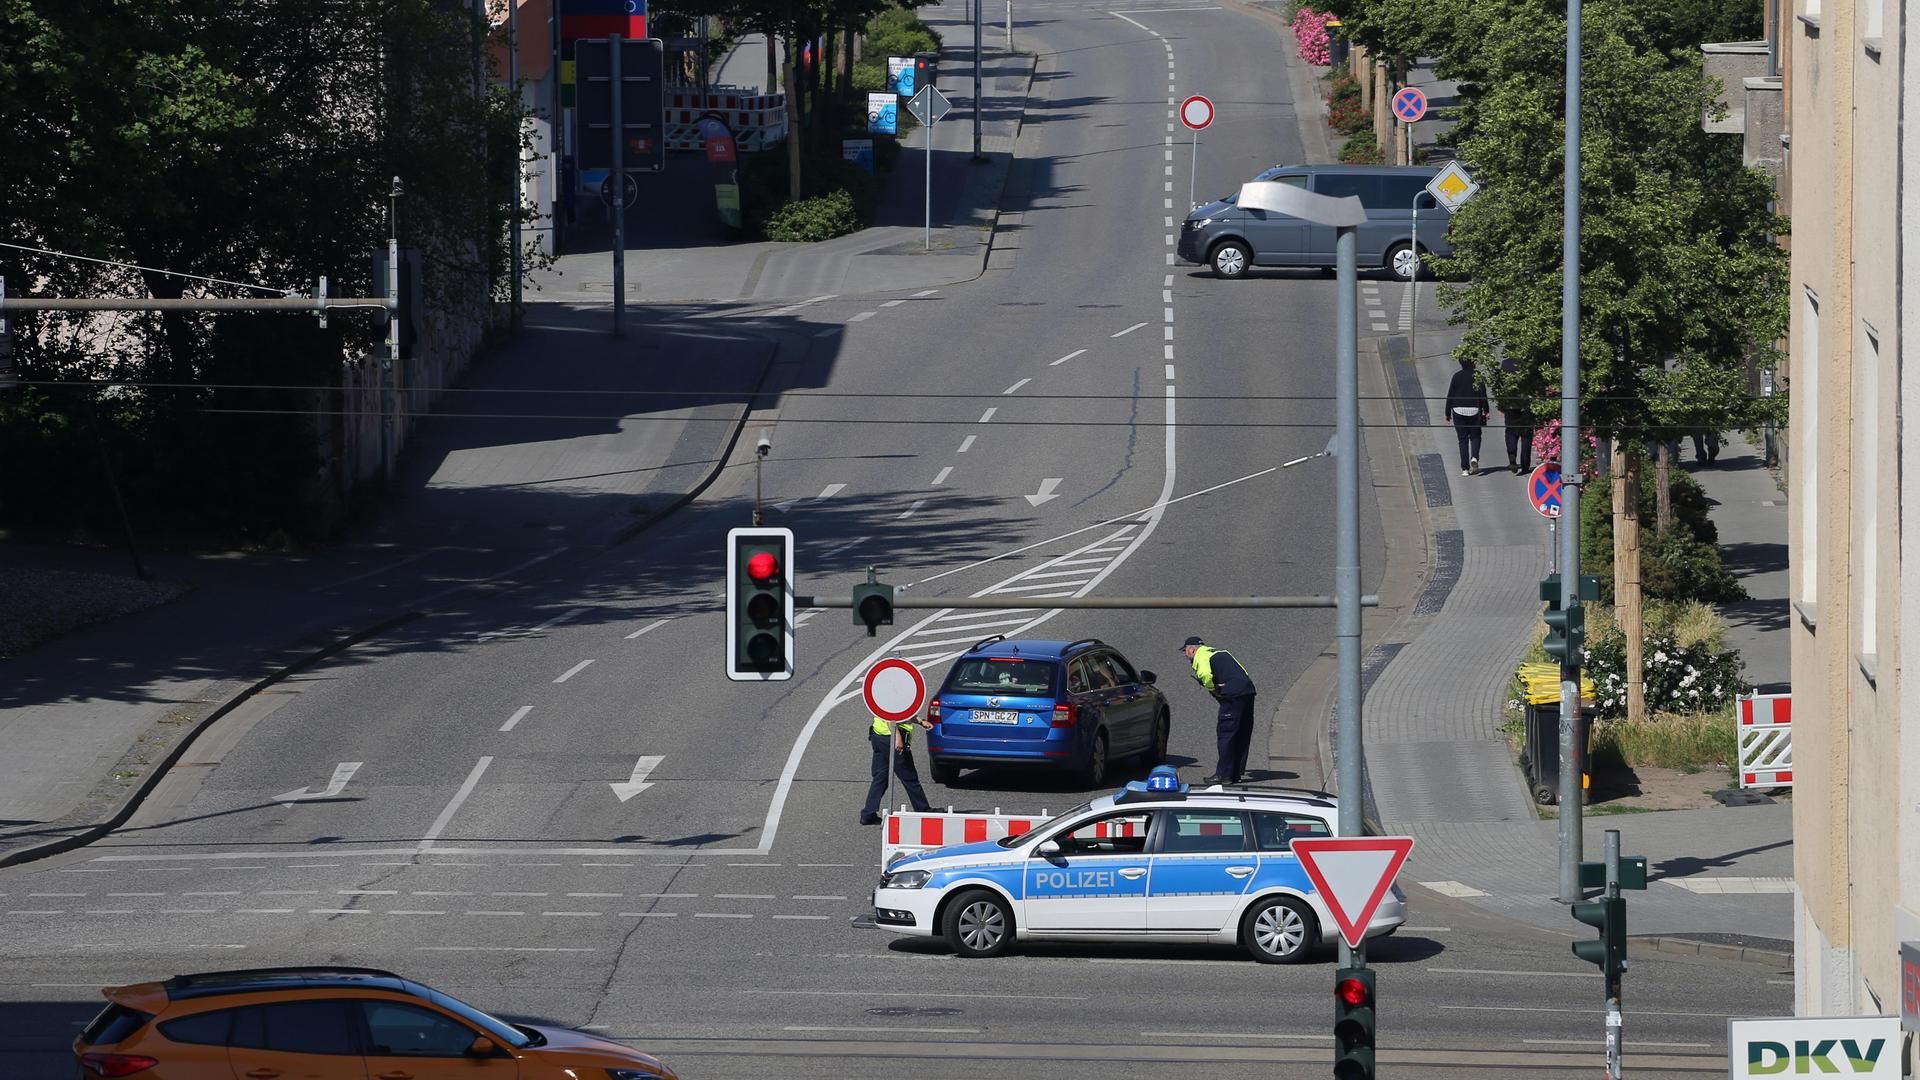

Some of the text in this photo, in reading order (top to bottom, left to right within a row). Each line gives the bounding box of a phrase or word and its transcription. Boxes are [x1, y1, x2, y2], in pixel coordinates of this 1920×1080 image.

[973, 711, 990, 720] SPN
[1036, 871, 1115, 889] POLIZEI
[1747, 1038, 1886, 1076] DKV
